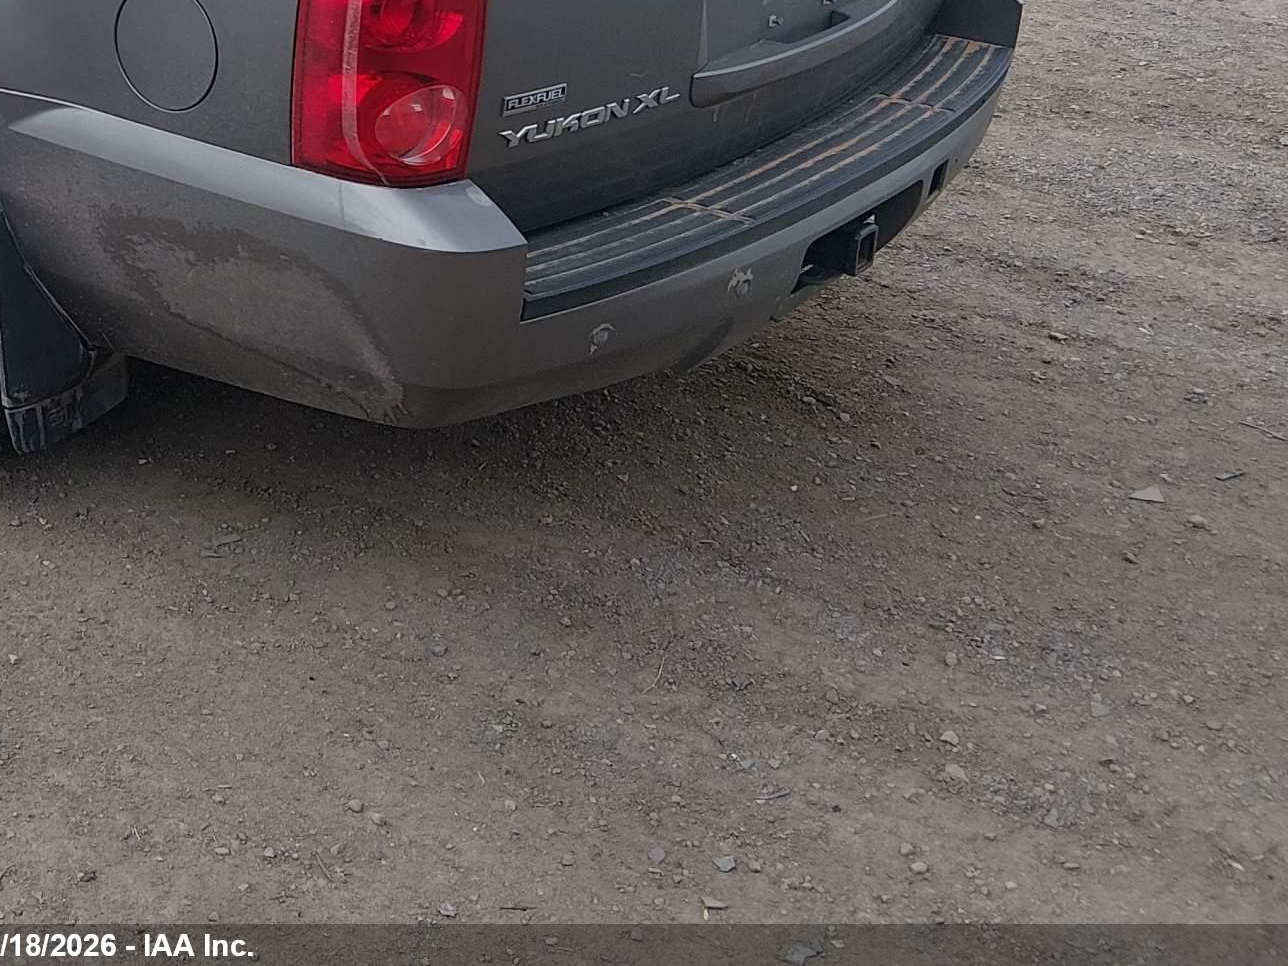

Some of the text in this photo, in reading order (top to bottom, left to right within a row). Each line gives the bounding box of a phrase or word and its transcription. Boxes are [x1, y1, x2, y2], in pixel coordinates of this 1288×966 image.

[498, 87, 681, 148] YUKON XL
[507, 88, 566, 110] FLEXFUEL
